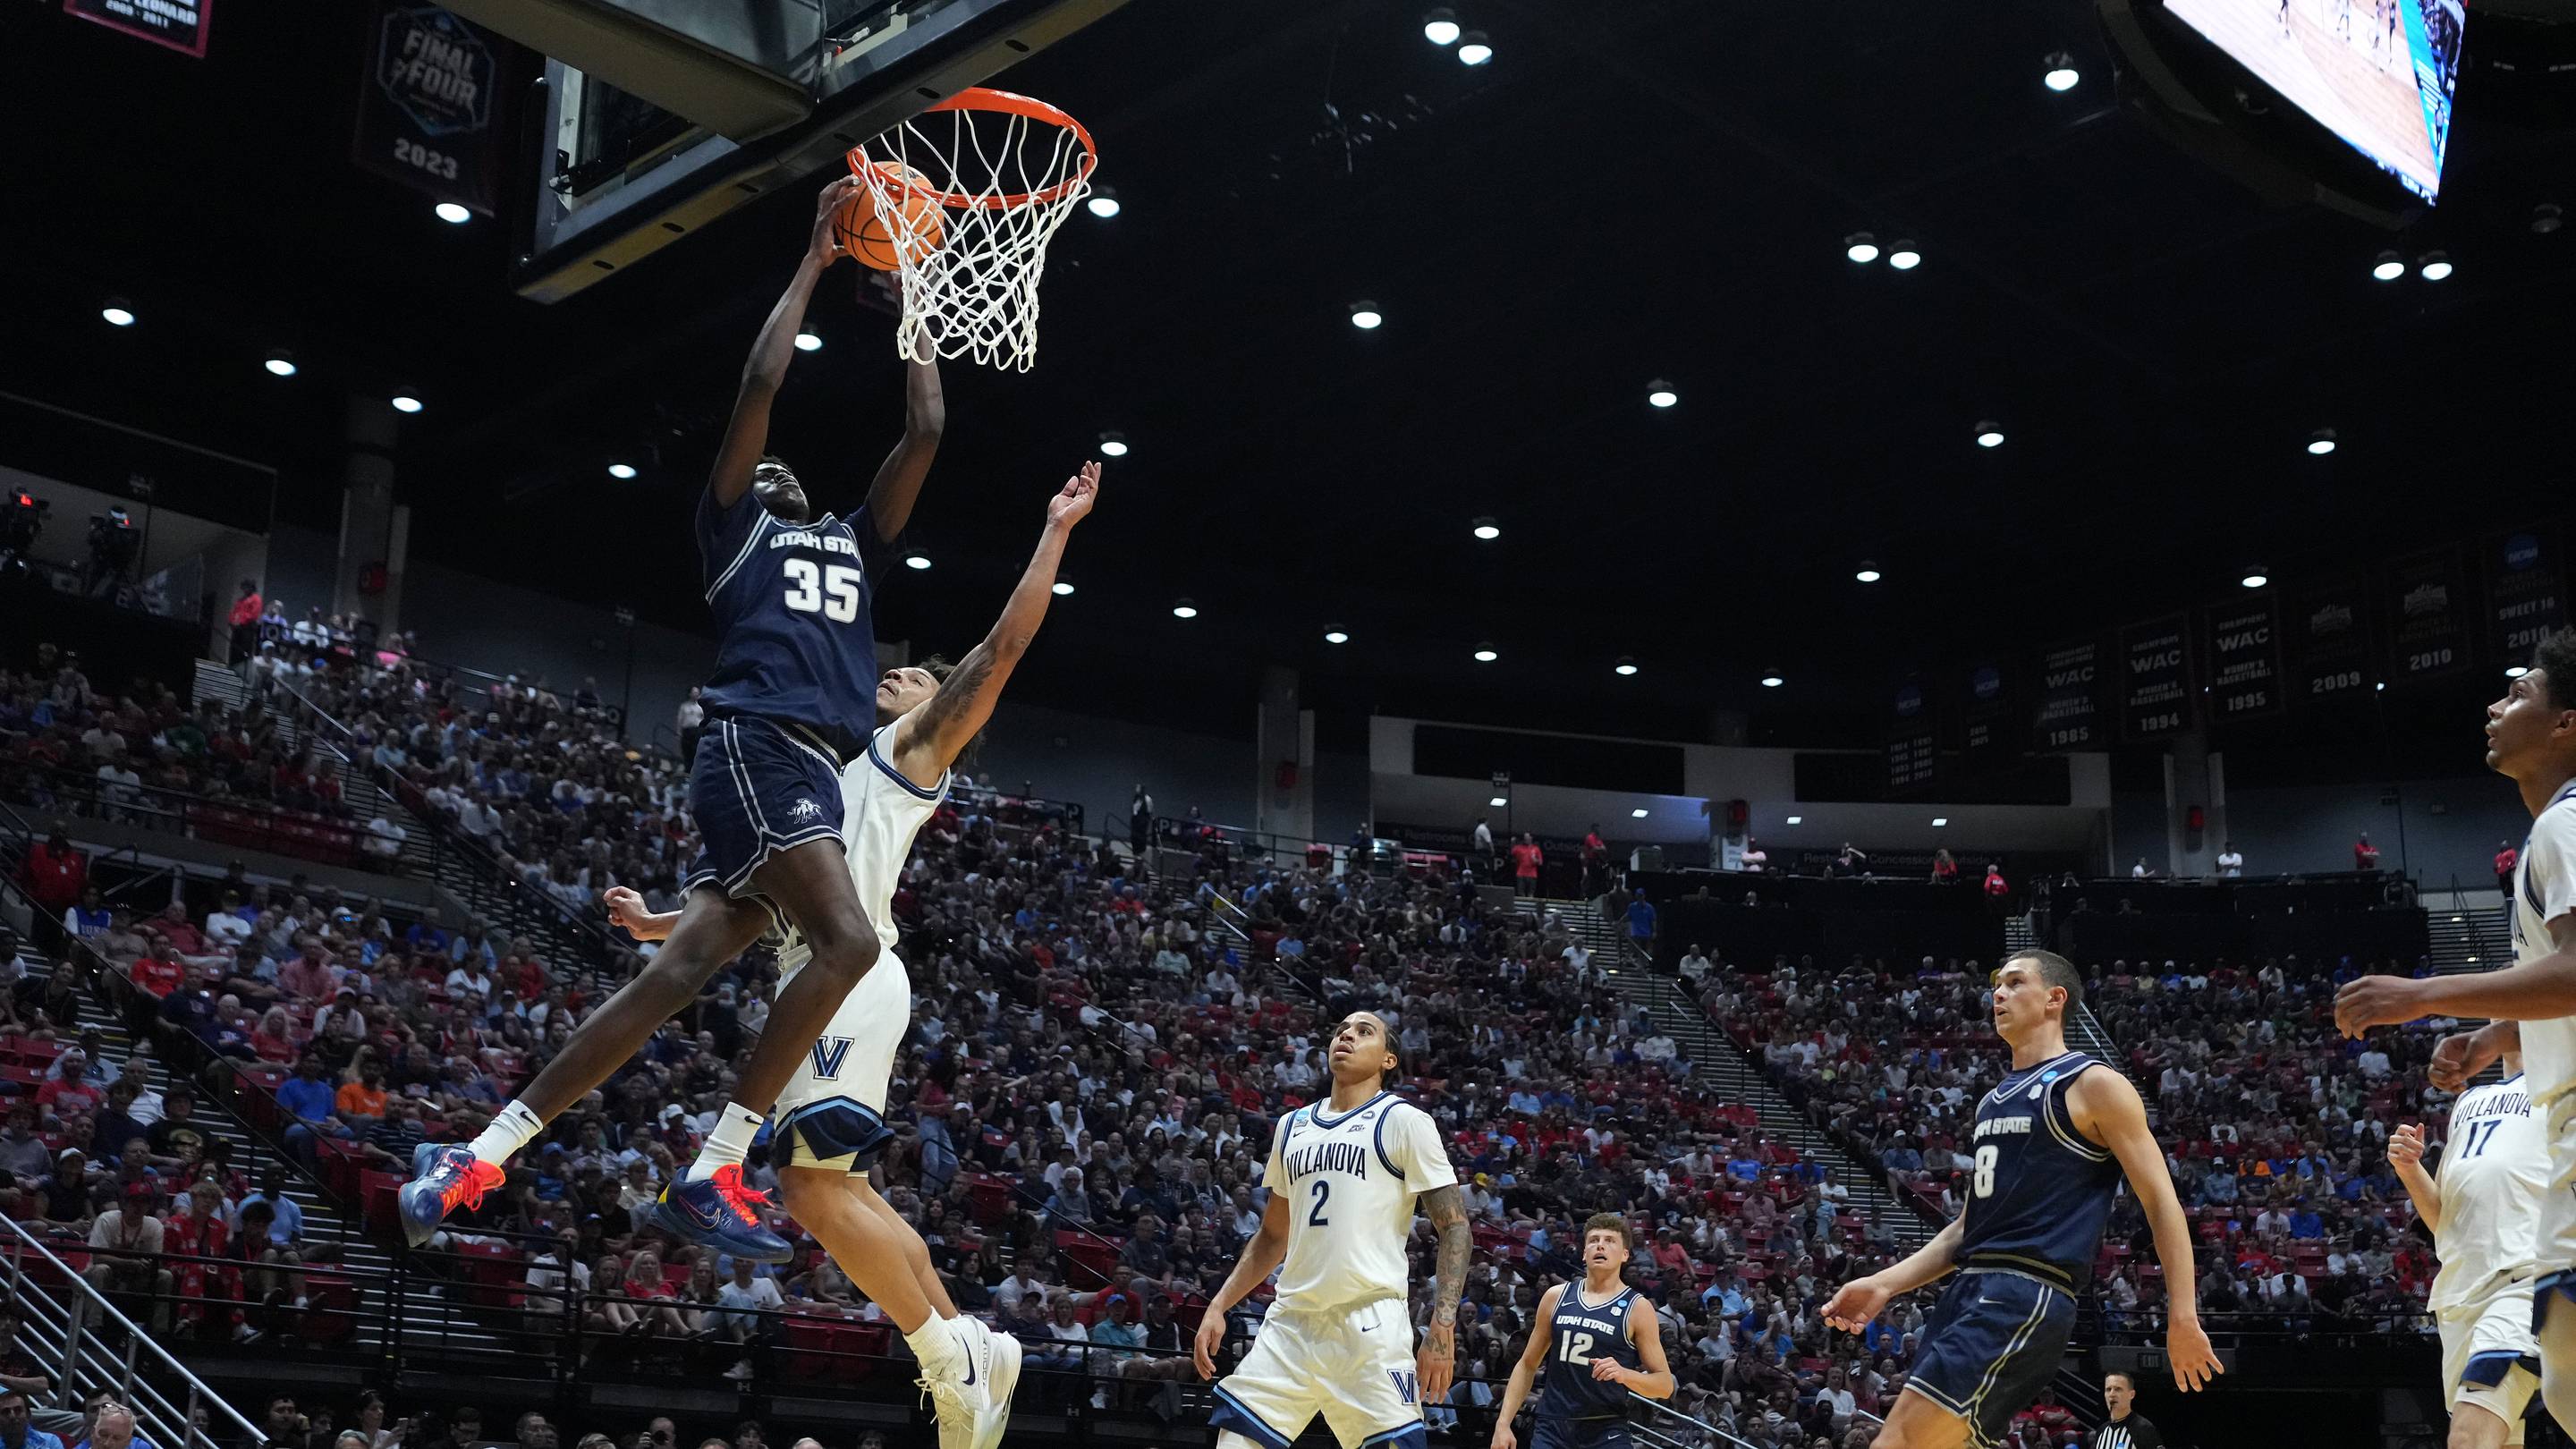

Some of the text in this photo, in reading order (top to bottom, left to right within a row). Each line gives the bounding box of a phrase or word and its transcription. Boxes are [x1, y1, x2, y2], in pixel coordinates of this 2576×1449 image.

[403, 29, 475, 77] FINAL
[405, 59, 477, 106] FOUR
[394, 137, 459, 180] 2023
[770, 531, 860, 560] UTAH STA
[784, 558, 860, 623] 35
[2499, 596, 2555, 621] SWEET 16
[2216, 627, 2269, 652] WAC
[2507, 624, 2549, 649] 2010
[2130, 649, 2182, 673] WAC
[2410, 648, 2453, 671] 2010
[2046, 665, 2095, 688] WAC
[2311, 671, 2361, 693] 2009
[2227, 691, 2267, 712] 1995
[2050, 726, 2089, 746] 1985
[2140, 712, 2180, 732] 1994
[809, 1036, 854, 1080] V
[1992, 1116, 2032, 1134] STATE
[2454, 1093, 2531, 1129] VILLANOVA
[2462, 1119, 2502, 1159] 17
[1286, 1143, 1366, 1186] VILLANOVA
[1974, 1145, 1998, 1199] 8
[1309, 1180, 1329, 1227] 2
[1556, 1316, 1615, 1335] UTAH STATE
[1559, 1330, 1594, 1366] 12
[1387, 1369, 1417, 1406] V
